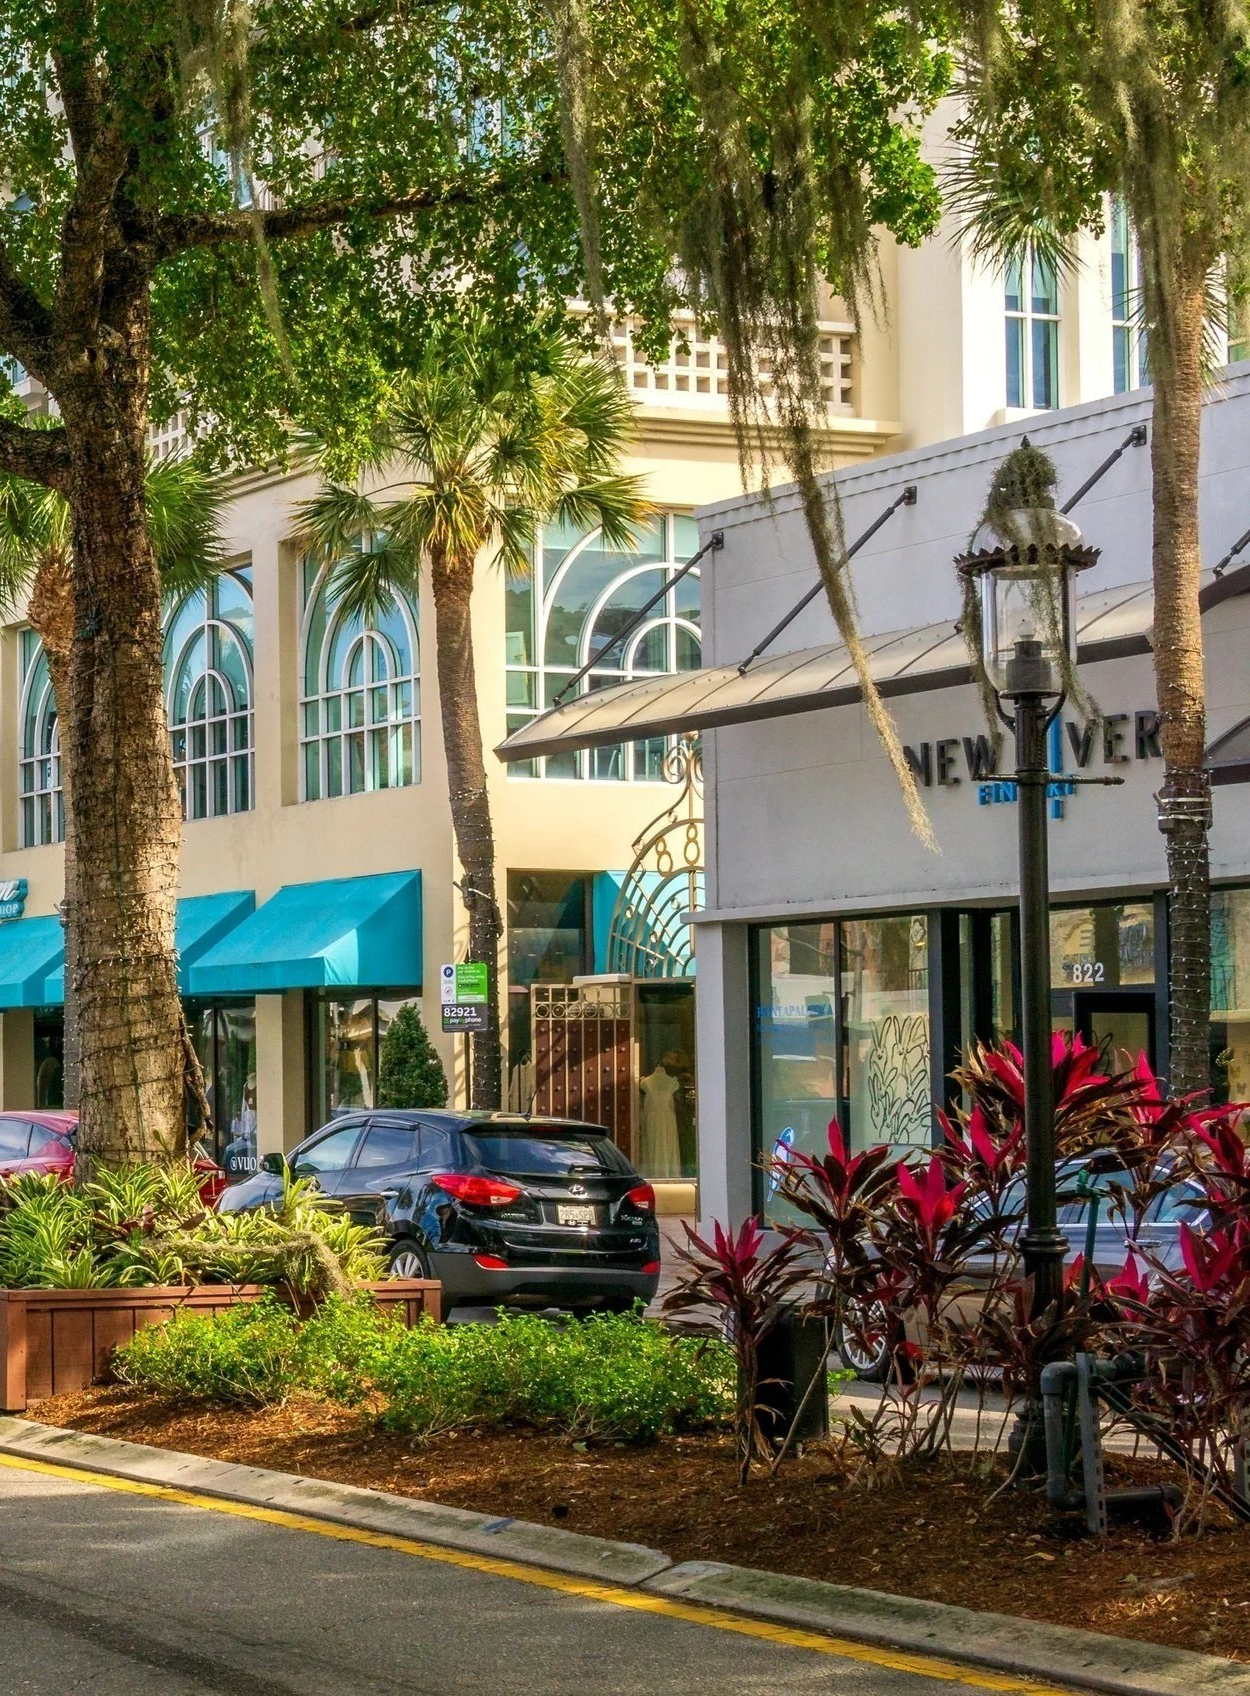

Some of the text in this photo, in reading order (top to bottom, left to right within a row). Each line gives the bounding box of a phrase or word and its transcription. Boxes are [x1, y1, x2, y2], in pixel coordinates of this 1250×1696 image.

[903, 732, 1001, 787] NEW
[978, 782, 1018, 805] FIN
[1072, 962, 1105, 984] 822
[443, 1006, 477, 1017] 82921
